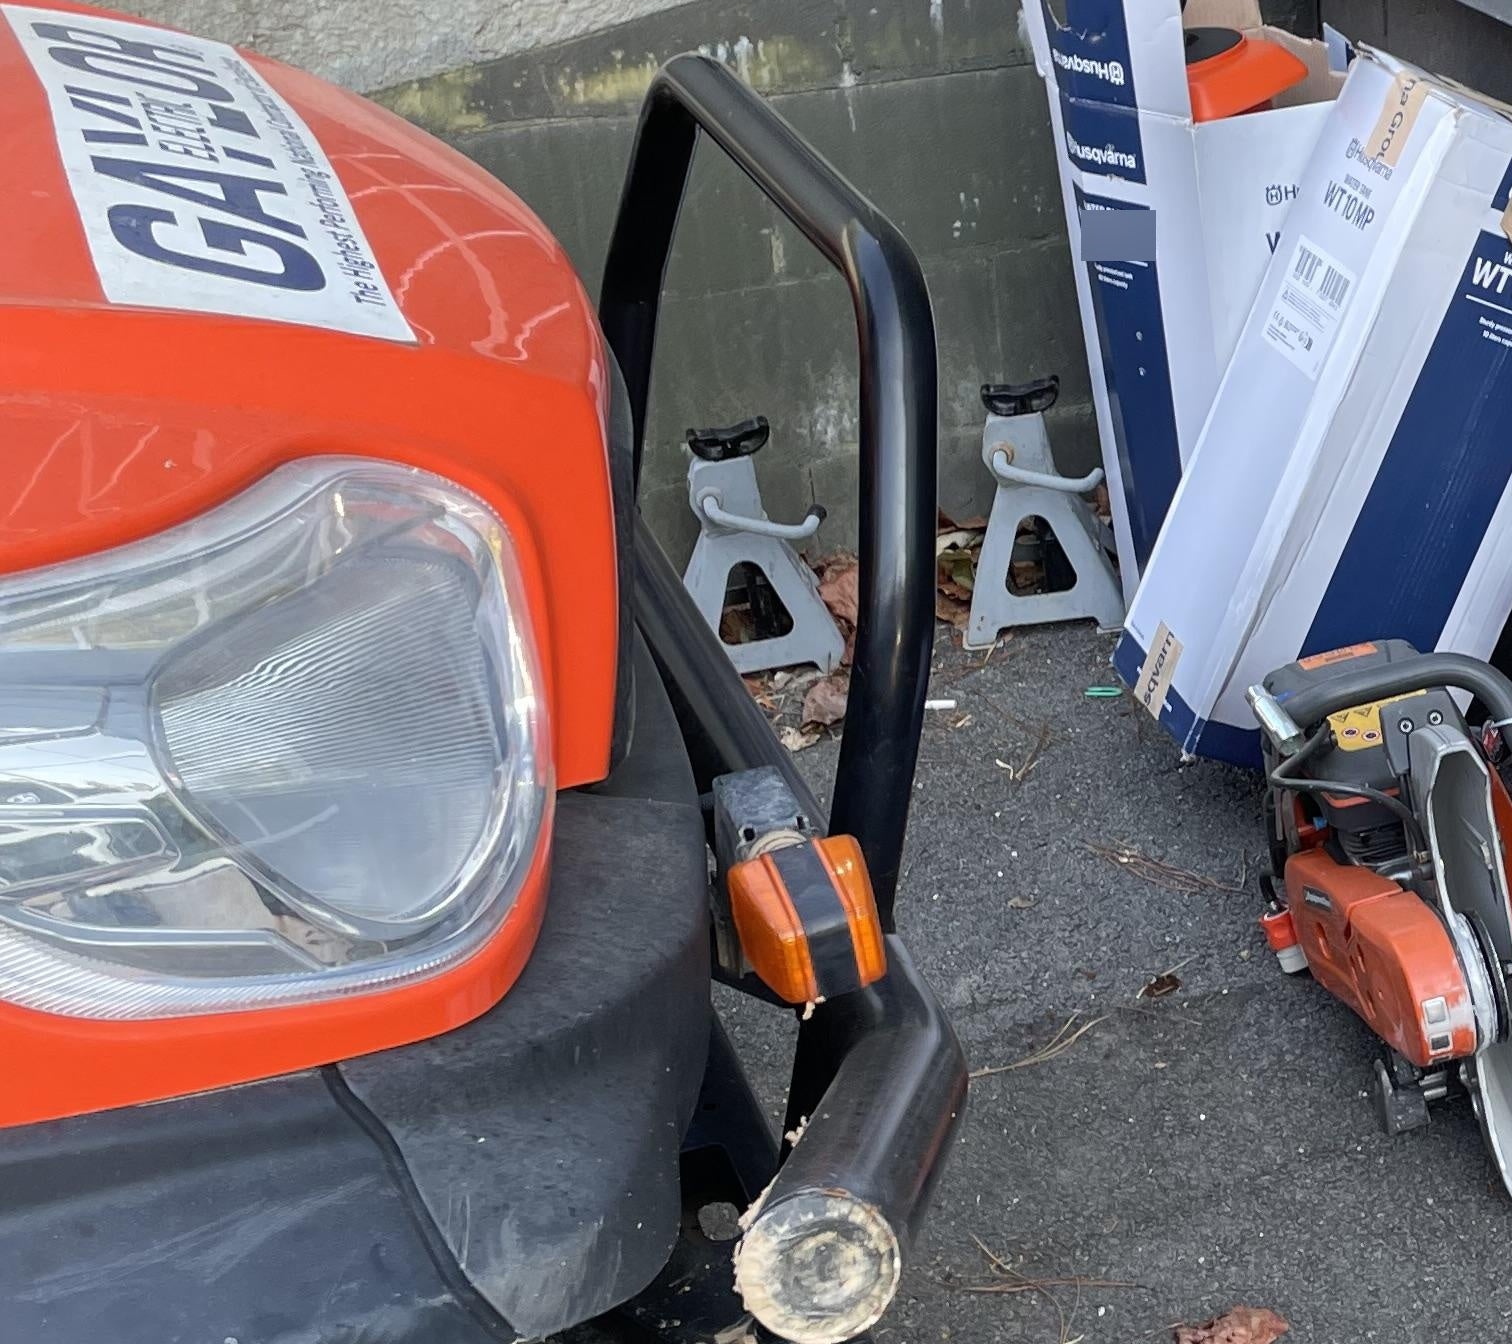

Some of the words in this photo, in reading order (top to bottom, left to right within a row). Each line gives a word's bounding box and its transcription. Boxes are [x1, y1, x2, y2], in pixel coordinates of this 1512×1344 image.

[135, 90, 220, 164] ELECTRIC
[30, 20, 327, 293] GAYLOR
[301, 166, 347, 231] Performing
[1323, 180, 1347, 212] WT
[1352, 200, 1375, 231] MP
[326, 231, 377, 280] Highest
[348, 278, 387, 307] The
